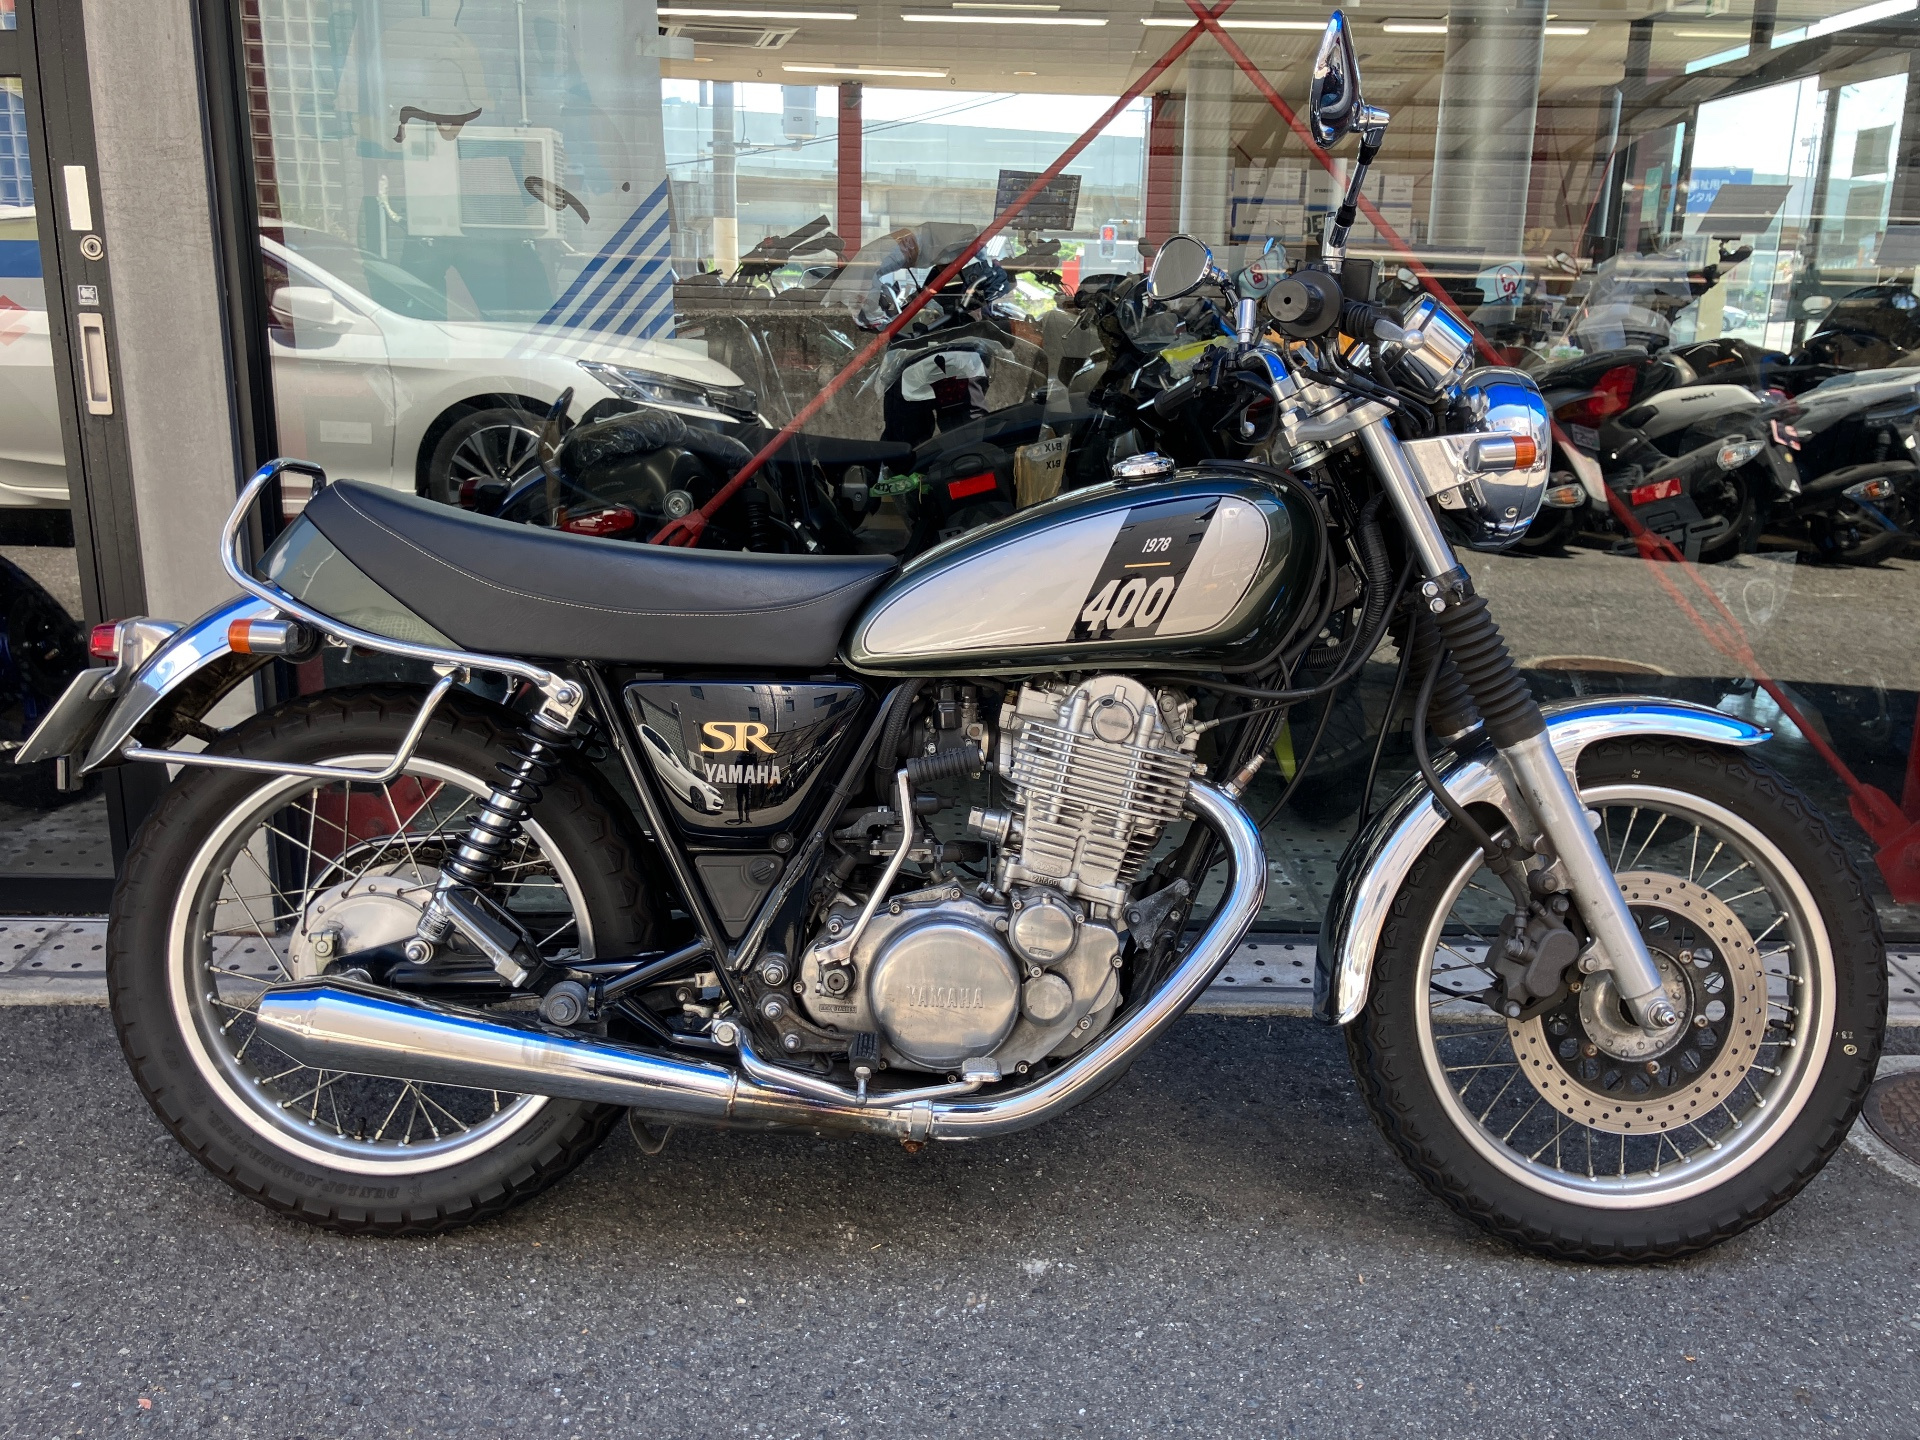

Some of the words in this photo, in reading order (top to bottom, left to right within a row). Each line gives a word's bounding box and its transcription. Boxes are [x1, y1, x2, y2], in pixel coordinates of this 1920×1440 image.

[1141, 536, 1172, 553] 1978
[1081, 576, 1175, 631] 400
[701, 721, 778, 753] SR
[704, 763, 781, 784] YAMAHA
[906, 984, 984, 1009] YAMAHA
